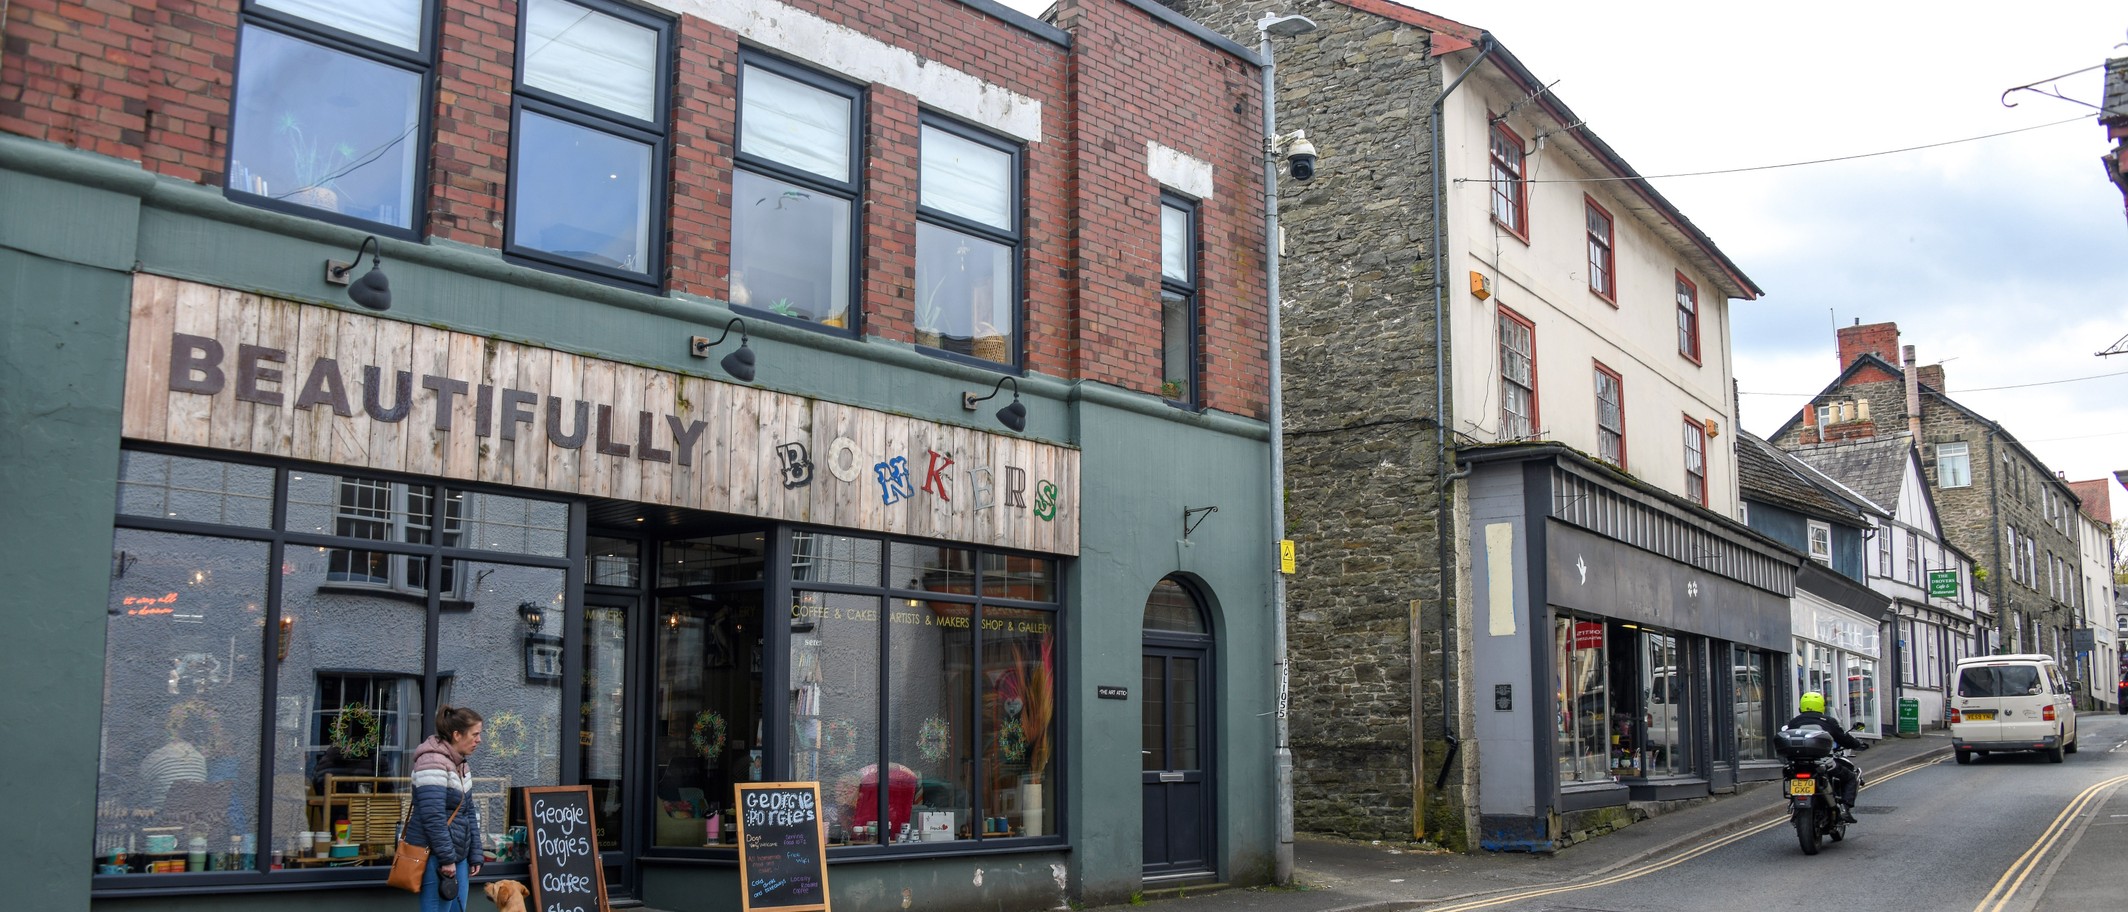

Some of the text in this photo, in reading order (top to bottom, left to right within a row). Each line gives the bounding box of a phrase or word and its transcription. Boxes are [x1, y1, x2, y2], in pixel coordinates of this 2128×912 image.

[169, 332, 1058, 521] BEAUTIFULLY BONKERS
[586, 609, 625, 621] MAKERS
[792, 605, 1052, 634] COFFEE & CAKES ARTISTS & MAKERS SHOP & GALLERY
[534, 799, 588, 835] Georgie
[537, 827, 590, 868] Porgies
[542, 872, 591, 894] Coffee
